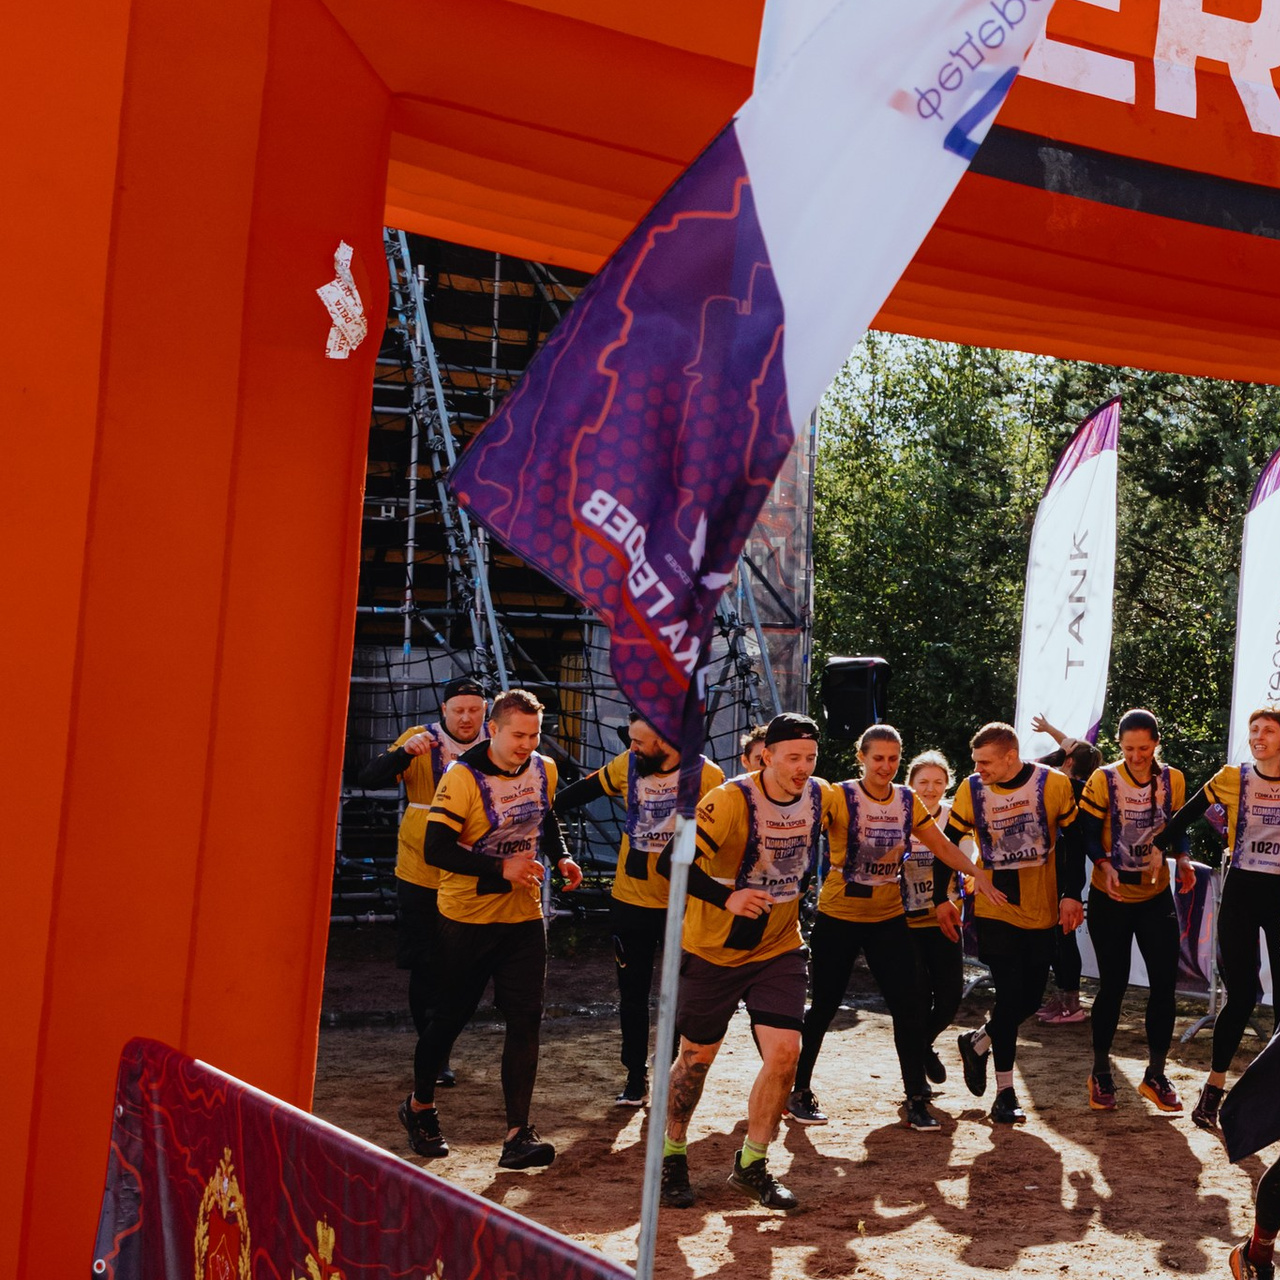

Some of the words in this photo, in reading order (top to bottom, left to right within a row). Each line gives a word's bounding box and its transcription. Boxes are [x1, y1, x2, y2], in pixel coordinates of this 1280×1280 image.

[335, 300, 353, 324] DELTA
[1064, 528, 1089, 681] TANK
[865, 862, 897, 876] 10207
